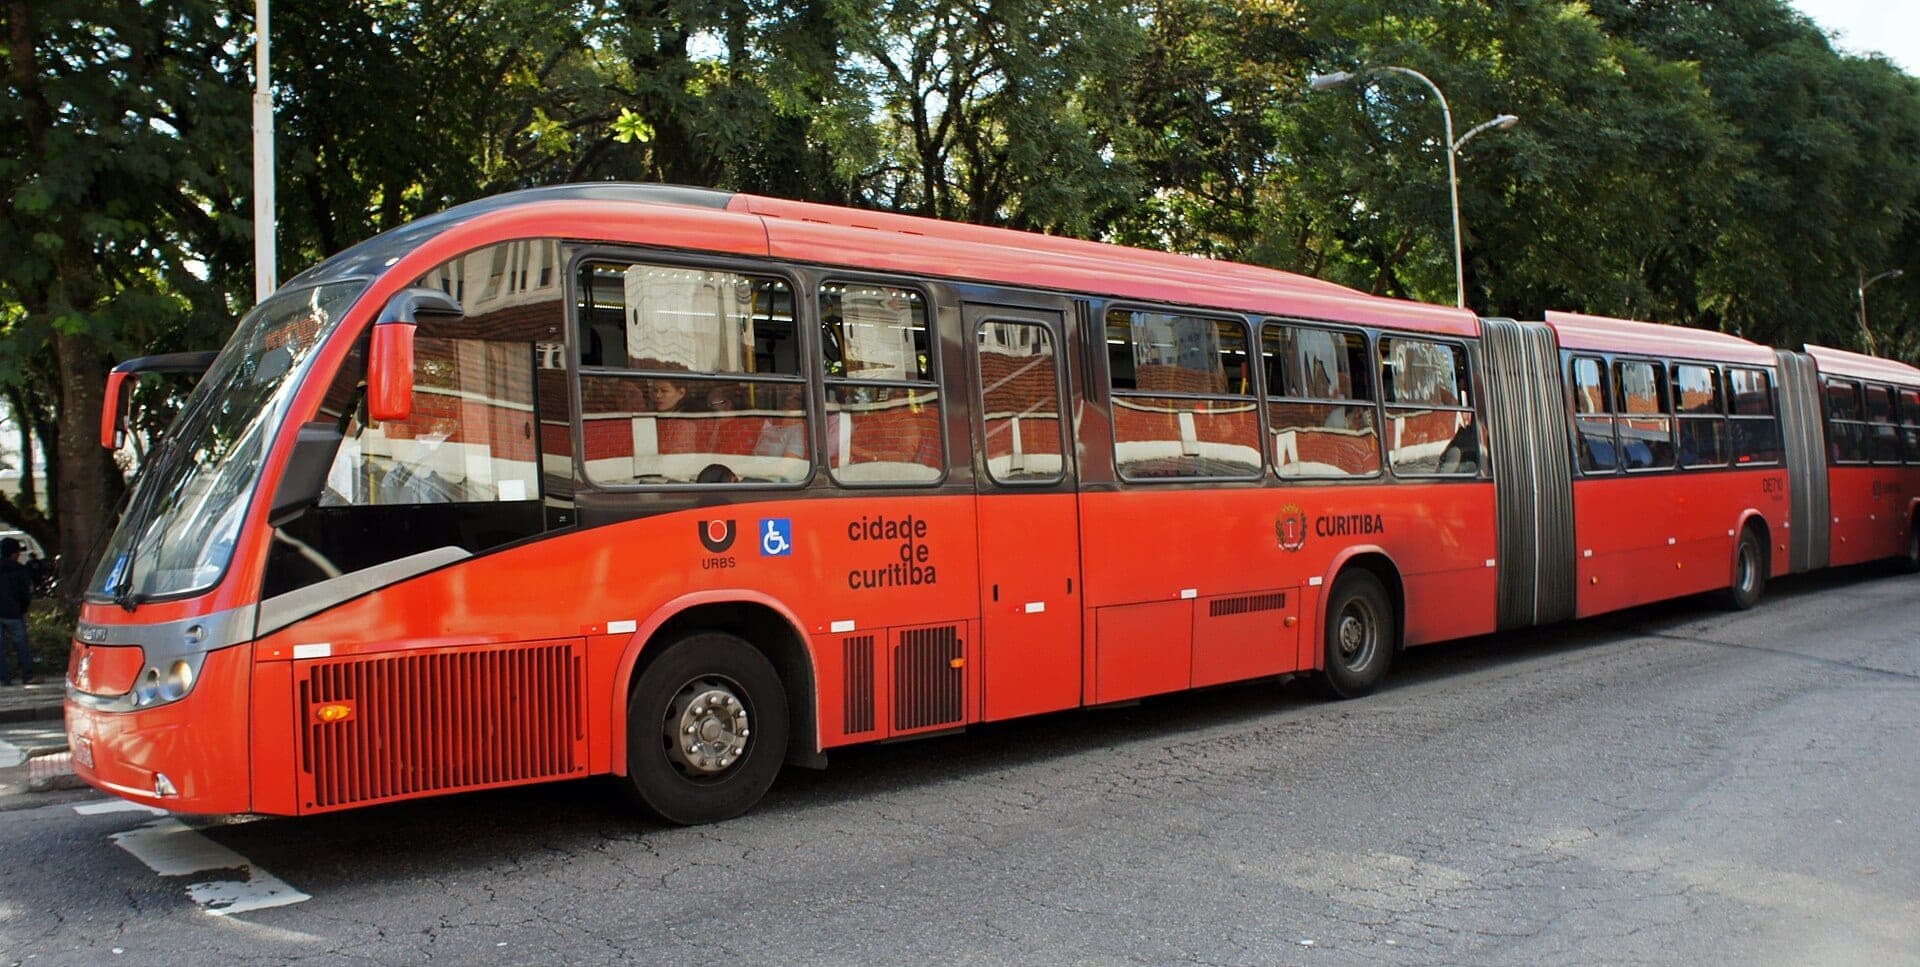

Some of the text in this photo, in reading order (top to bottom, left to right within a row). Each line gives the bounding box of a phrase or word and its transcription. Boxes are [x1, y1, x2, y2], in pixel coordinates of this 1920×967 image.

[848, 515, 928, 541] cidade
[1315, 514, 1384, 537] CURITIBA
[702, 557, 736, 569] URBS
[900, 539, 929, 563] de
[848, 562, 937, 589] curitiba
